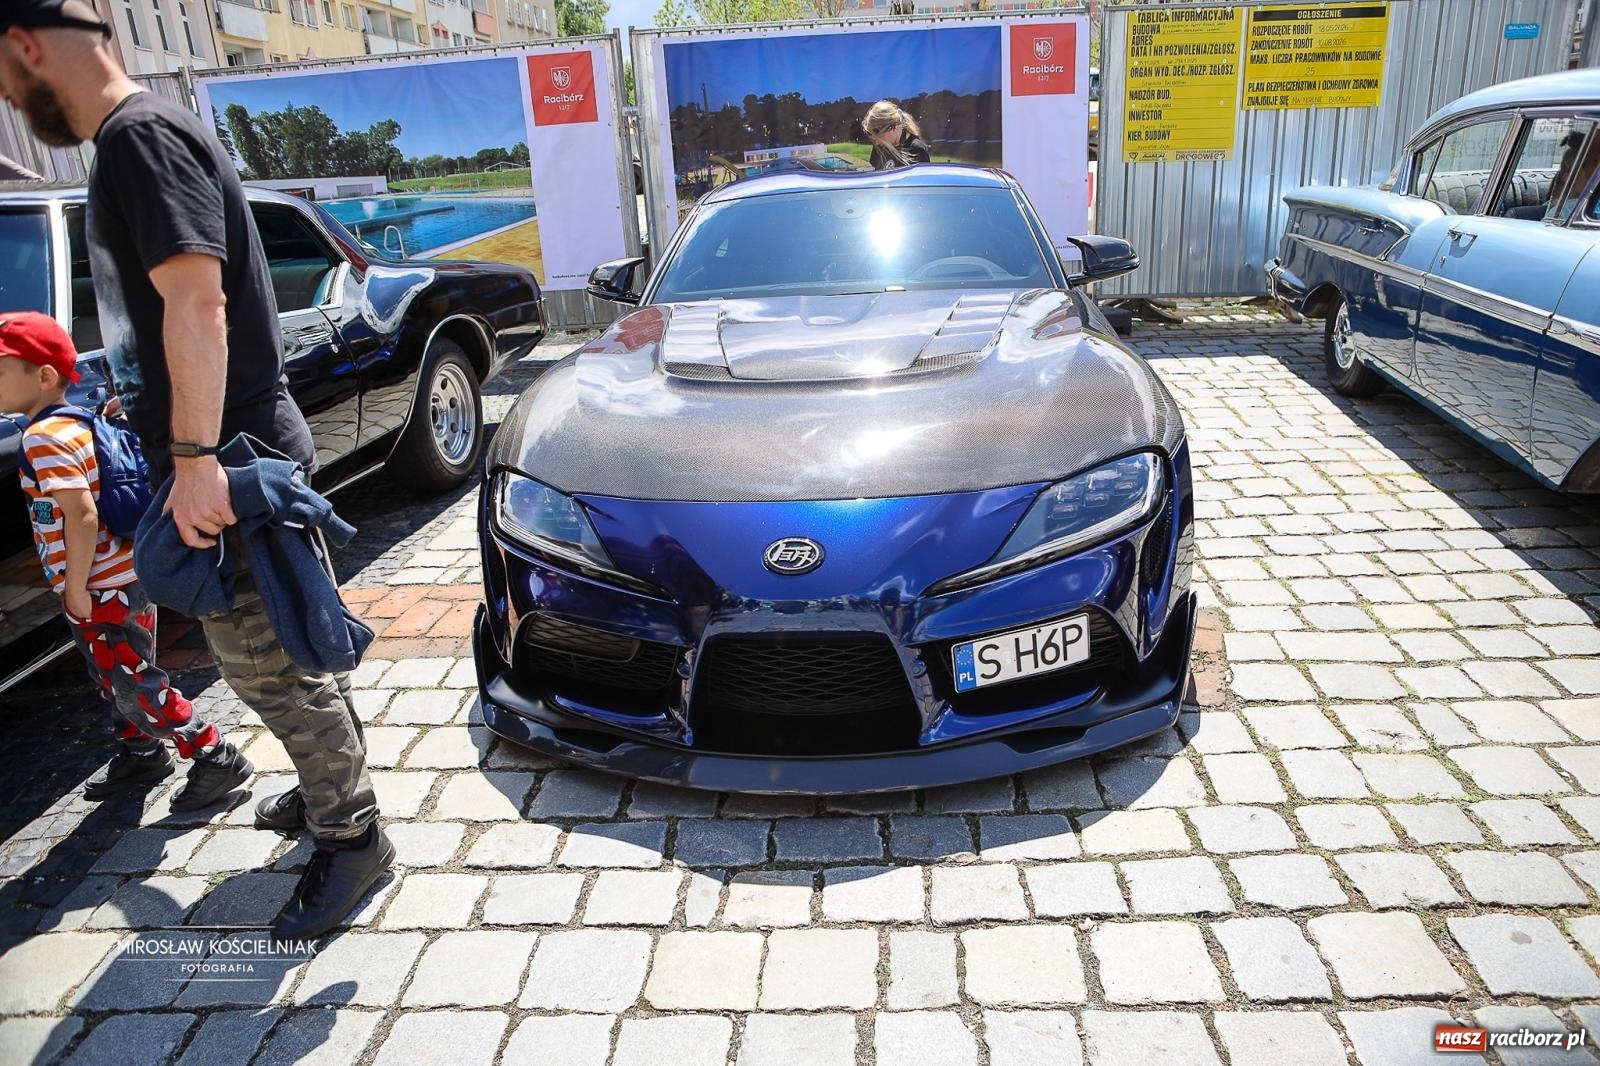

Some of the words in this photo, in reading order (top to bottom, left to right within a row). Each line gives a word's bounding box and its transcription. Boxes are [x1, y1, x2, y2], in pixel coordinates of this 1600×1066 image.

[1137, 11, 1169, 23] TABLICA
[1171, 9, 1234, 22] INFORMACYJNA
[1297, 9, 1342, 19] OGŁOSZENIE
[1132, 24, 1161, 35] BUDOWA
[1252, 24, 1291, 36] ROZPOCZĘCIE
[1292, 22, 1313, 35] ROBÓT
[1131, 35, 1153, 46] ADRES
[1251, 38, 1292, 50] ZAKOŃCZENIE
[1293, 37, 1313, 49] ROBÓT
[1131, 46, 1147, 57] DATA
[1149, 45, 1152, 57] I
[1154, 45, 1163, 56] NR
[1164, 43, 1236, 56] POZWOLENIA/ZGŁOSZ.
[1249, 53, 1270, 65] MAKS.
[1272, 52, 1293, 64] LICZBA
[1295, 50, 1342, 63] PRACOWNIKÓW
[1344, 51, 1353, 62] NA
[1355, 50, 1381, 61] BUDOWIE
[1023, 64, 1064, 75] Racibórz
[1130, 66, 1152, 78] ORGAN
[1155, 66, 1171, 77] WYD.
[1172, 65, 1208, 77] DEC./ROZP.
[1209, 64, 1235, 76] ZGŁOSZ.
[1305, 67, 1316, 76] 25
[1248, 82, 1265, 92] PLAN
[1266, 79, 1317, 91] BEZPIECZEŃSTWA
[1318, 80, 1321, 90] I
[1322, 79, 1352, 90] OCHRONY
[1352, 79, 1379, 90] ZDROWIA
[543, 93, 584, 104] Racibórz
[1129, 87, 1155, 100] NADZÓR
[1156, 89, 1172, 100] BUD.
[1247, 95, 1278, 106] ZNAJDUJE
[1279, 95, 1289, 107] SIĘ
[1129, 110, 1162, 121] INWESTOR
[1128, 130, 1143, 141] KIER.
[1144, 129, 1171, 141] BUDOWY
[977, 643, 1002, 680] S
[1014, 623, 1083, 673] H6P
[959, 672, 974, 683] PL
